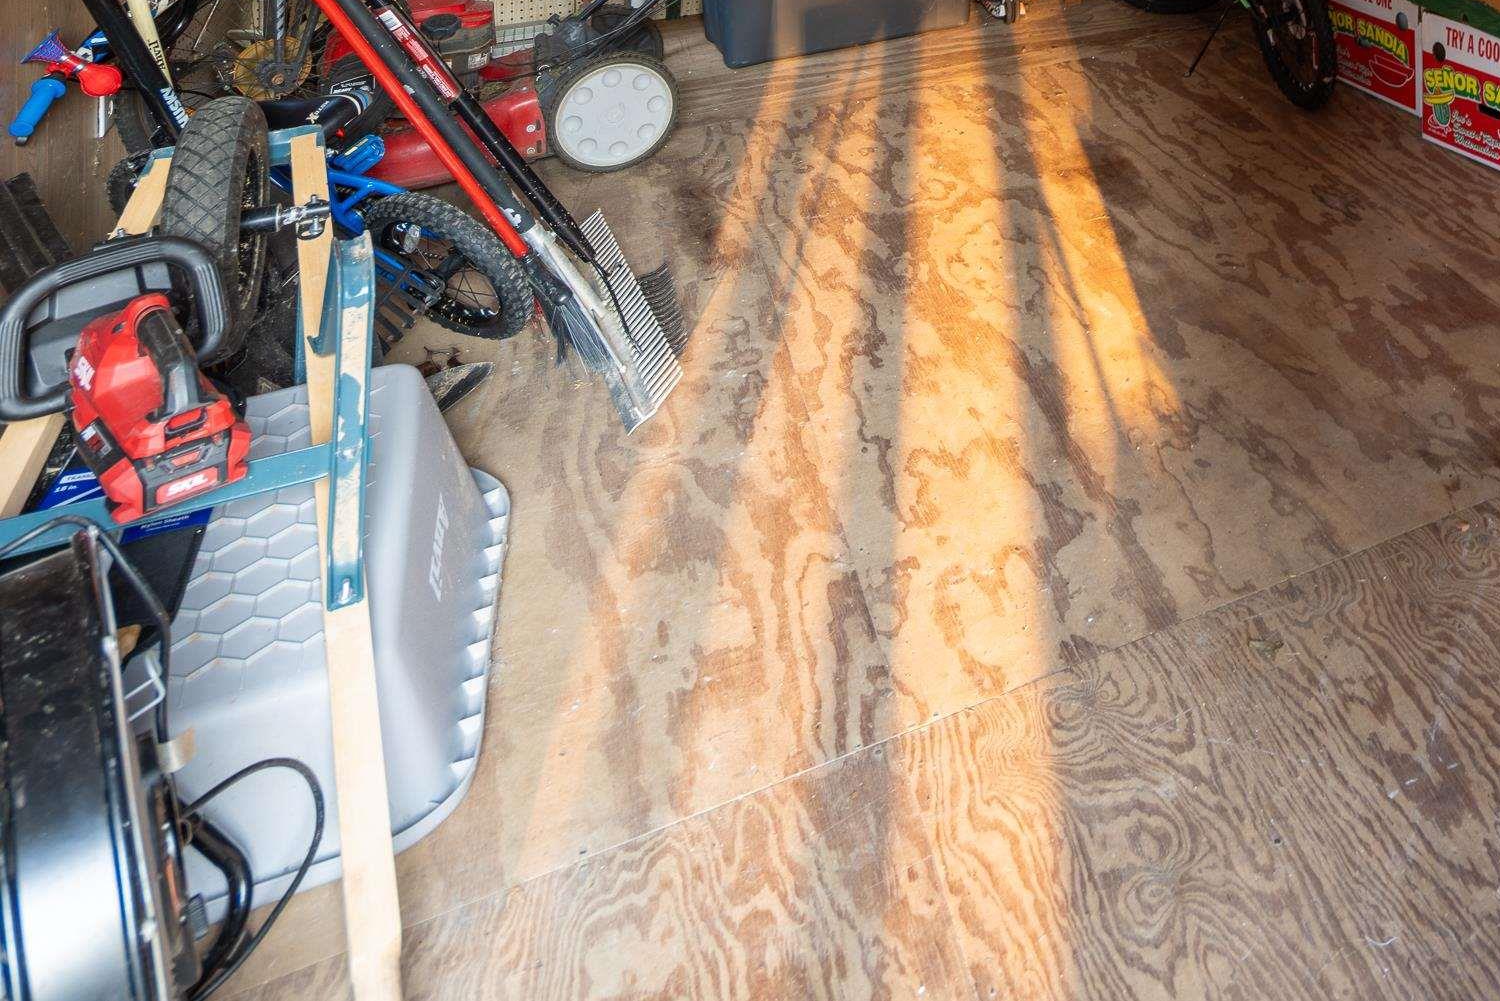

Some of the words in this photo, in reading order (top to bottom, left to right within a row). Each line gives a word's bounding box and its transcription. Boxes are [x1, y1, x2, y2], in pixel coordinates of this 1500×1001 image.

[148, 39, 166, 70] Anvil
[1356, 18, 1409, 67] SANDIA
[1446, 27, 1465, 50] TRY
[1467, 34, 1474, 53] A
[1424, 65, 1481, 103] SEÑOR
[160, 86, 191, 129] HUSKY
[166, 473, 208, 496] SKIL
[163, 514, 190, 525] Sheath
